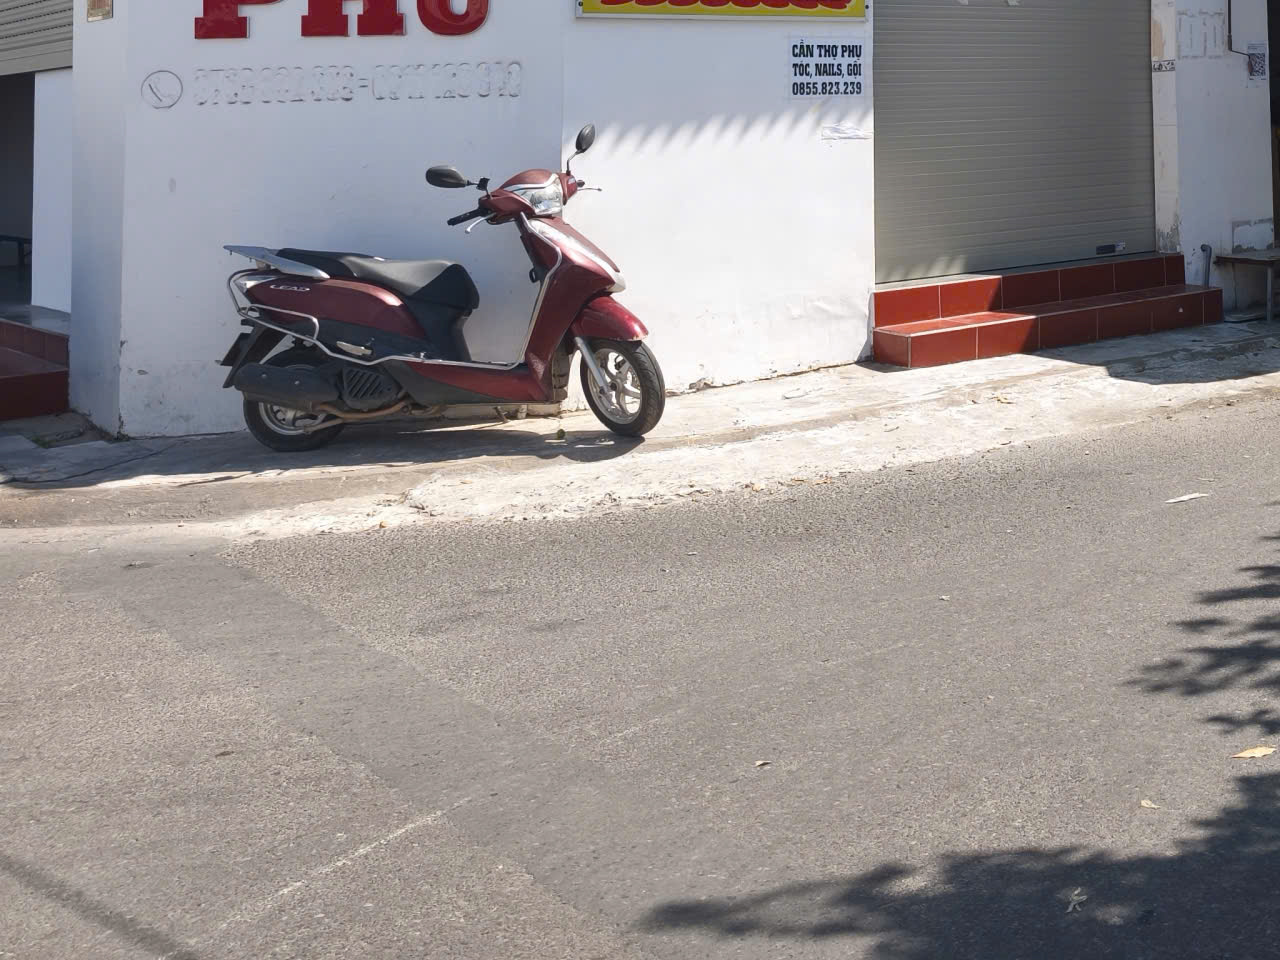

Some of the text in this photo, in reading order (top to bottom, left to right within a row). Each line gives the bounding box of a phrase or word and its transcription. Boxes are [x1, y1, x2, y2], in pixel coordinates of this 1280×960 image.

[791, 38, 862, 60] CẦN THỢ PHỤ
[792, 60, 862, 79] TÓC, NAILS, GỘI
[792, 81, 862, 96] 0855.823.239
[269, 284, 310, 292] LEAD
